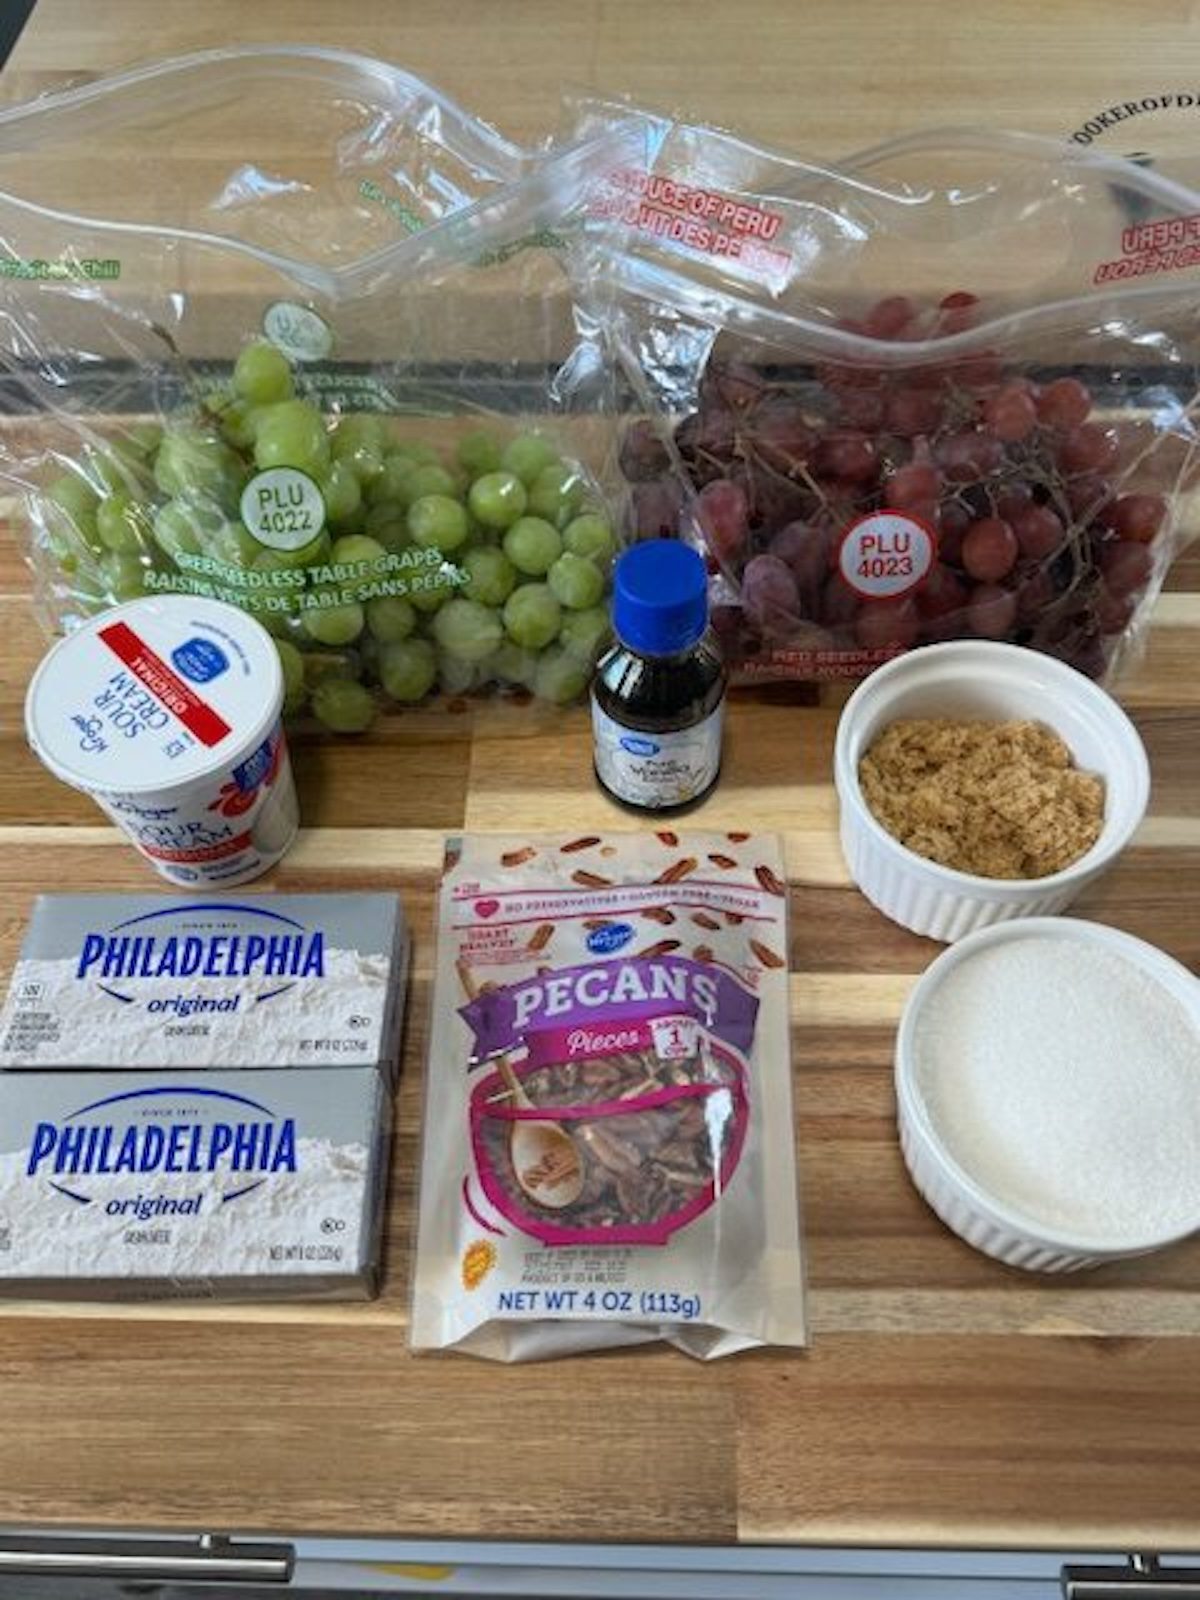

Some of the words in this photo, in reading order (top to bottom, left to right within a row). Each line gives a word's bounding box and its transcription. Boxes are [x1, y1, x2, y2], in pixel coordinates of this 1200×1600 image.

[690, 190, 717, 217] OF
[719, 199, 781, 240] PERU
[672, 217, 711, 249] DES
[259, 484, 304, 509] PLU
[259, 509, 313, 534] 4022
[860, 533, 911, 556] PLU
[309, 562, 369, 585] TABLE
[857, 557, 914, 579] 4023
[266, 595, 292, 612] DE
[296, 591, 353, 611] TABLE
[357, 577, 408, 602] SANS
[130, 655, 188, 715] ORIGINAL
[93, 688, 147, 739] SOUR
[108, 670, 171, 731] CREAM
[76, 931, 325, 980] PHILADELPHIA
[147, 994, 241, 1018] original
[510, 963, 719, 1028] PECANS
[565, 1028, 640, 1056] Pieces
[27, 1118, 297, 1176] PHILADELPHIA
[105, 1194, 203, 1220] original
[498, 1291, 540, 1312] NET
[543, 1291, 578, 1311] WT
[583, 1290, 597, 1311] 4
[601, 1291, 634, 1312] OZ
[640, 1290, 702, 1319] (113g)
